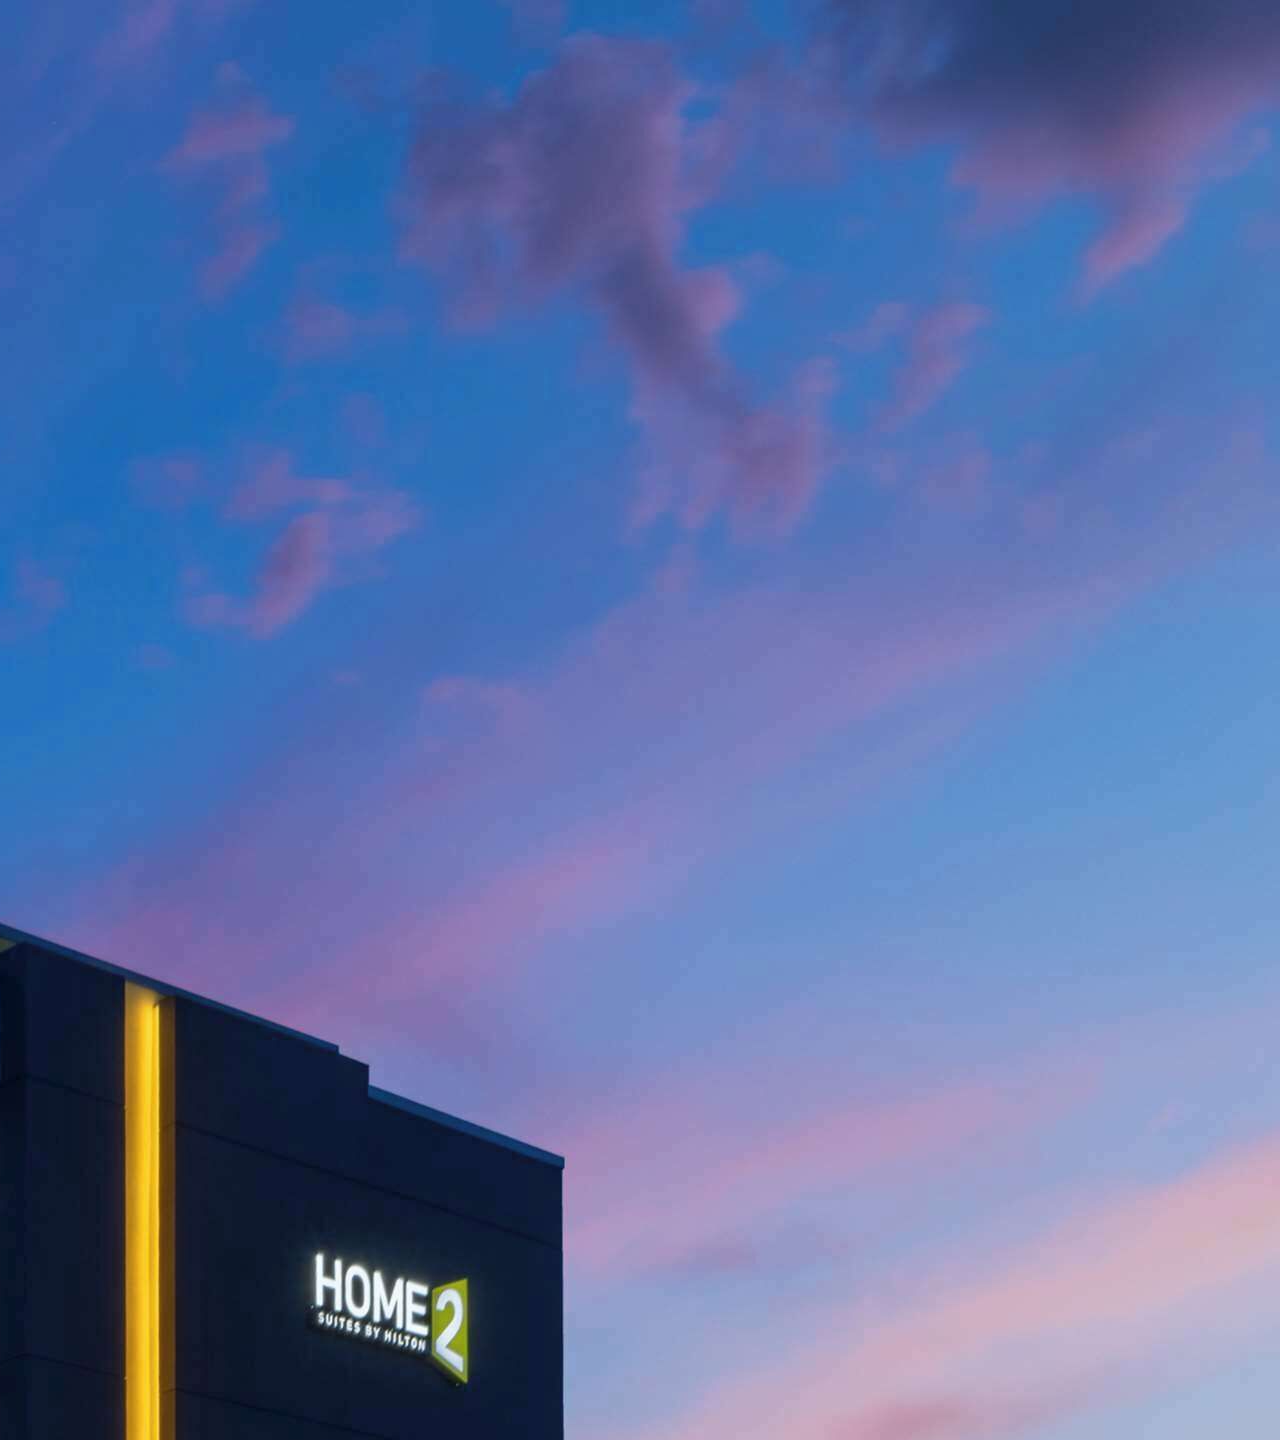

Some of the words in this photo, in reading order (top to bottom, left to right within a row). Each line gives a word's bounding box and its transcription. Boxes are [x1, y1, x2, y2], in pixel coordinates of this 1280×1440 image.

[317, 1311, 361, 1334] SUITES
[365, 1324, 381, 1340] BY
[384, 1329, 427, 1352] HILTON
